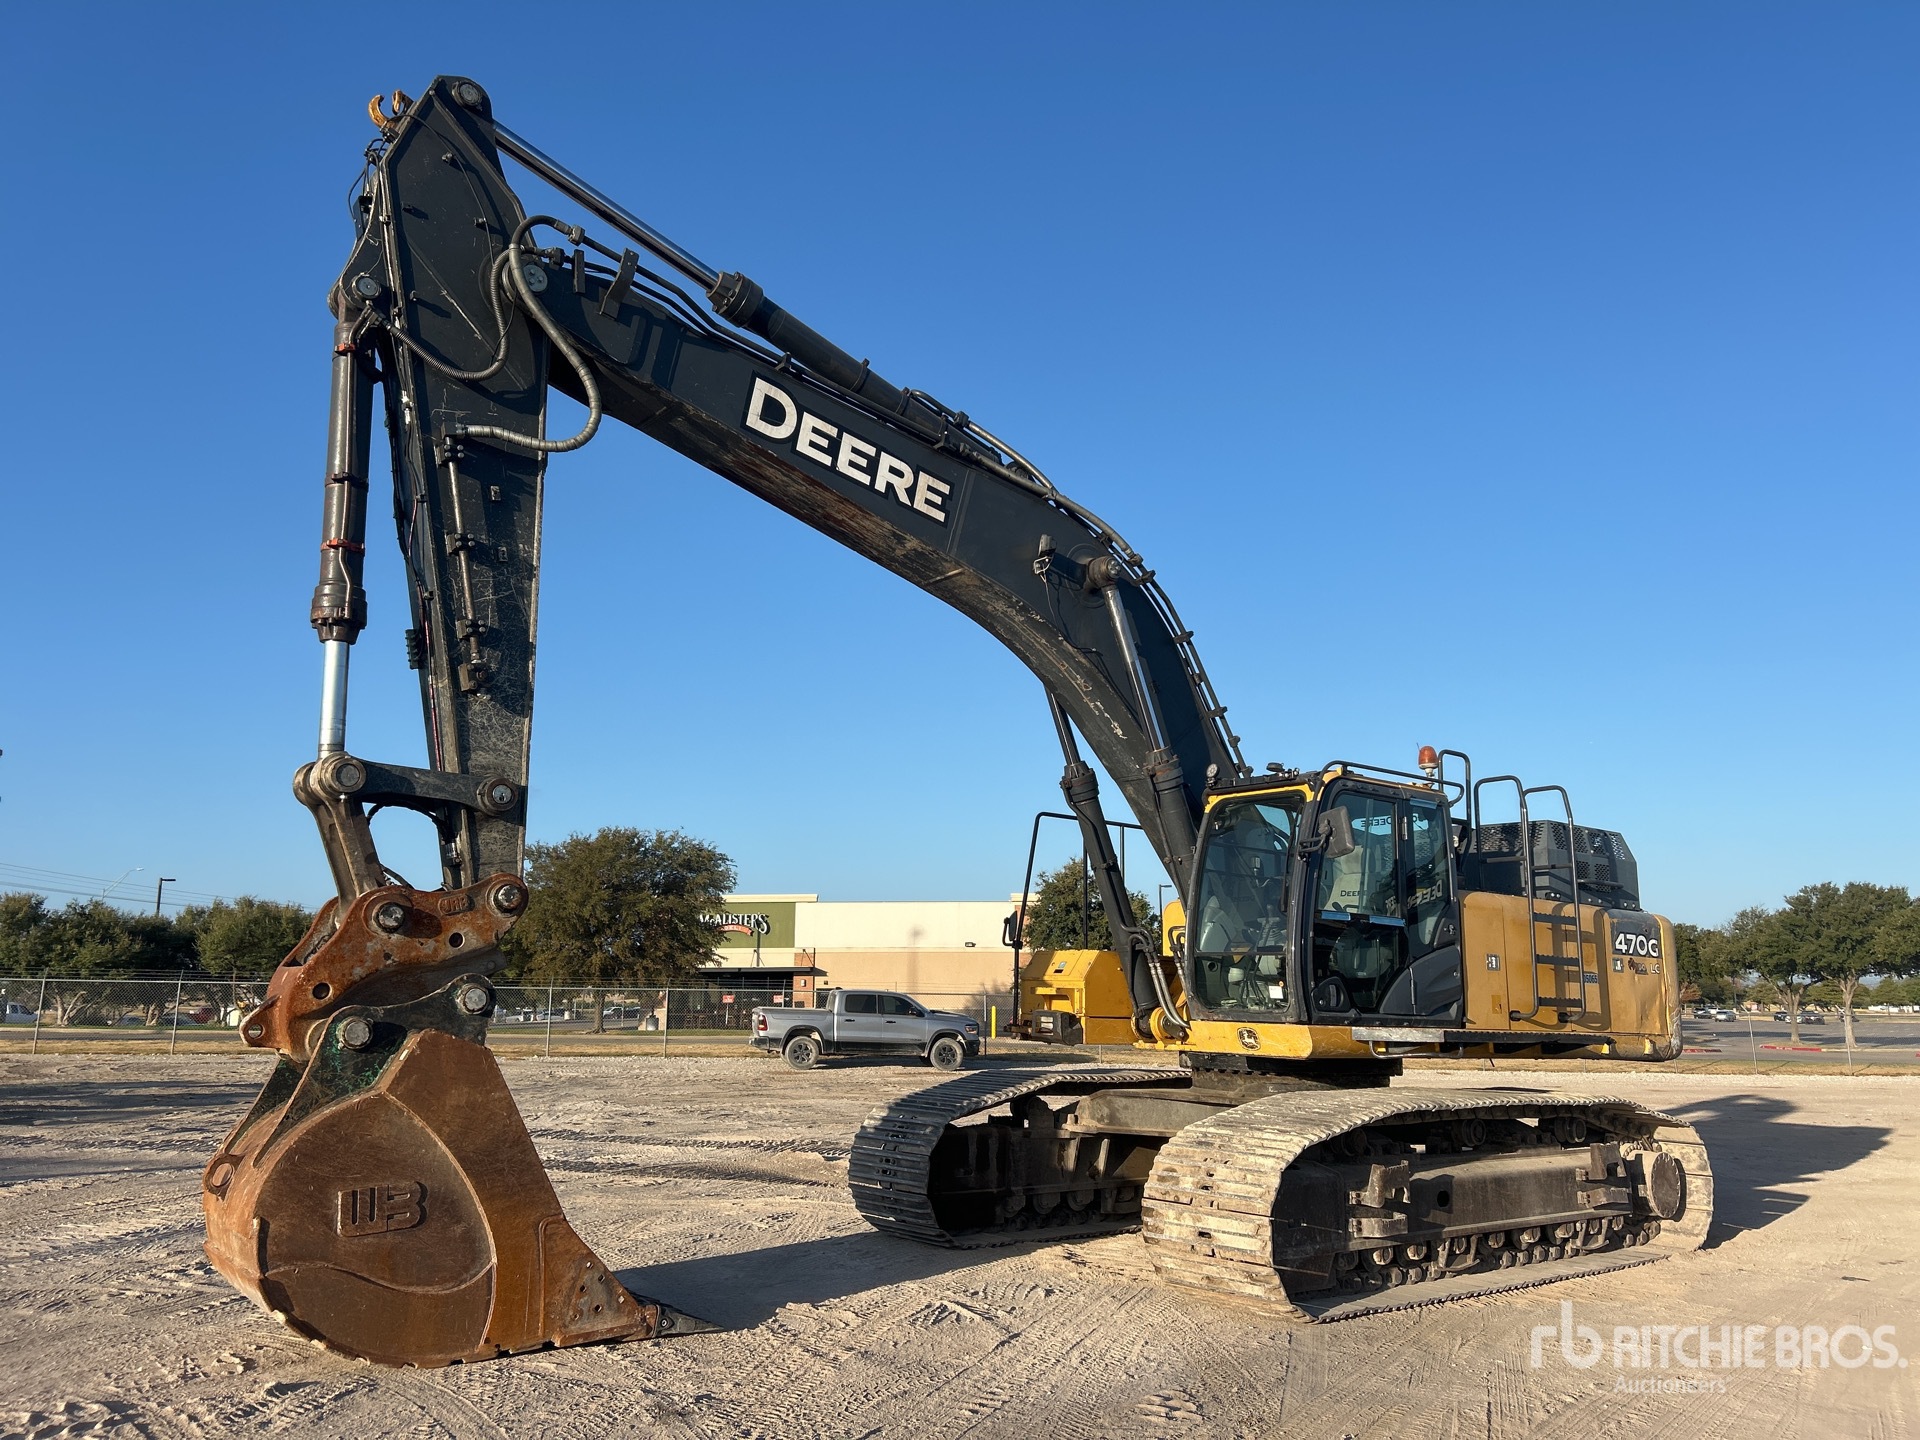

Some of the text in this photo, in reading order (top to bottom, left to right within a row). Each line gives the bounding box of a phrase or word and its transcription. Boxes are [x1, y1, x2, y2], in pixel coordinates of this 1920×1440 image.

[745, 377, 951, 523] DEERE
[1615, 933, 1659, 957] 470G
[1650, 962, 1661, 974] LC
